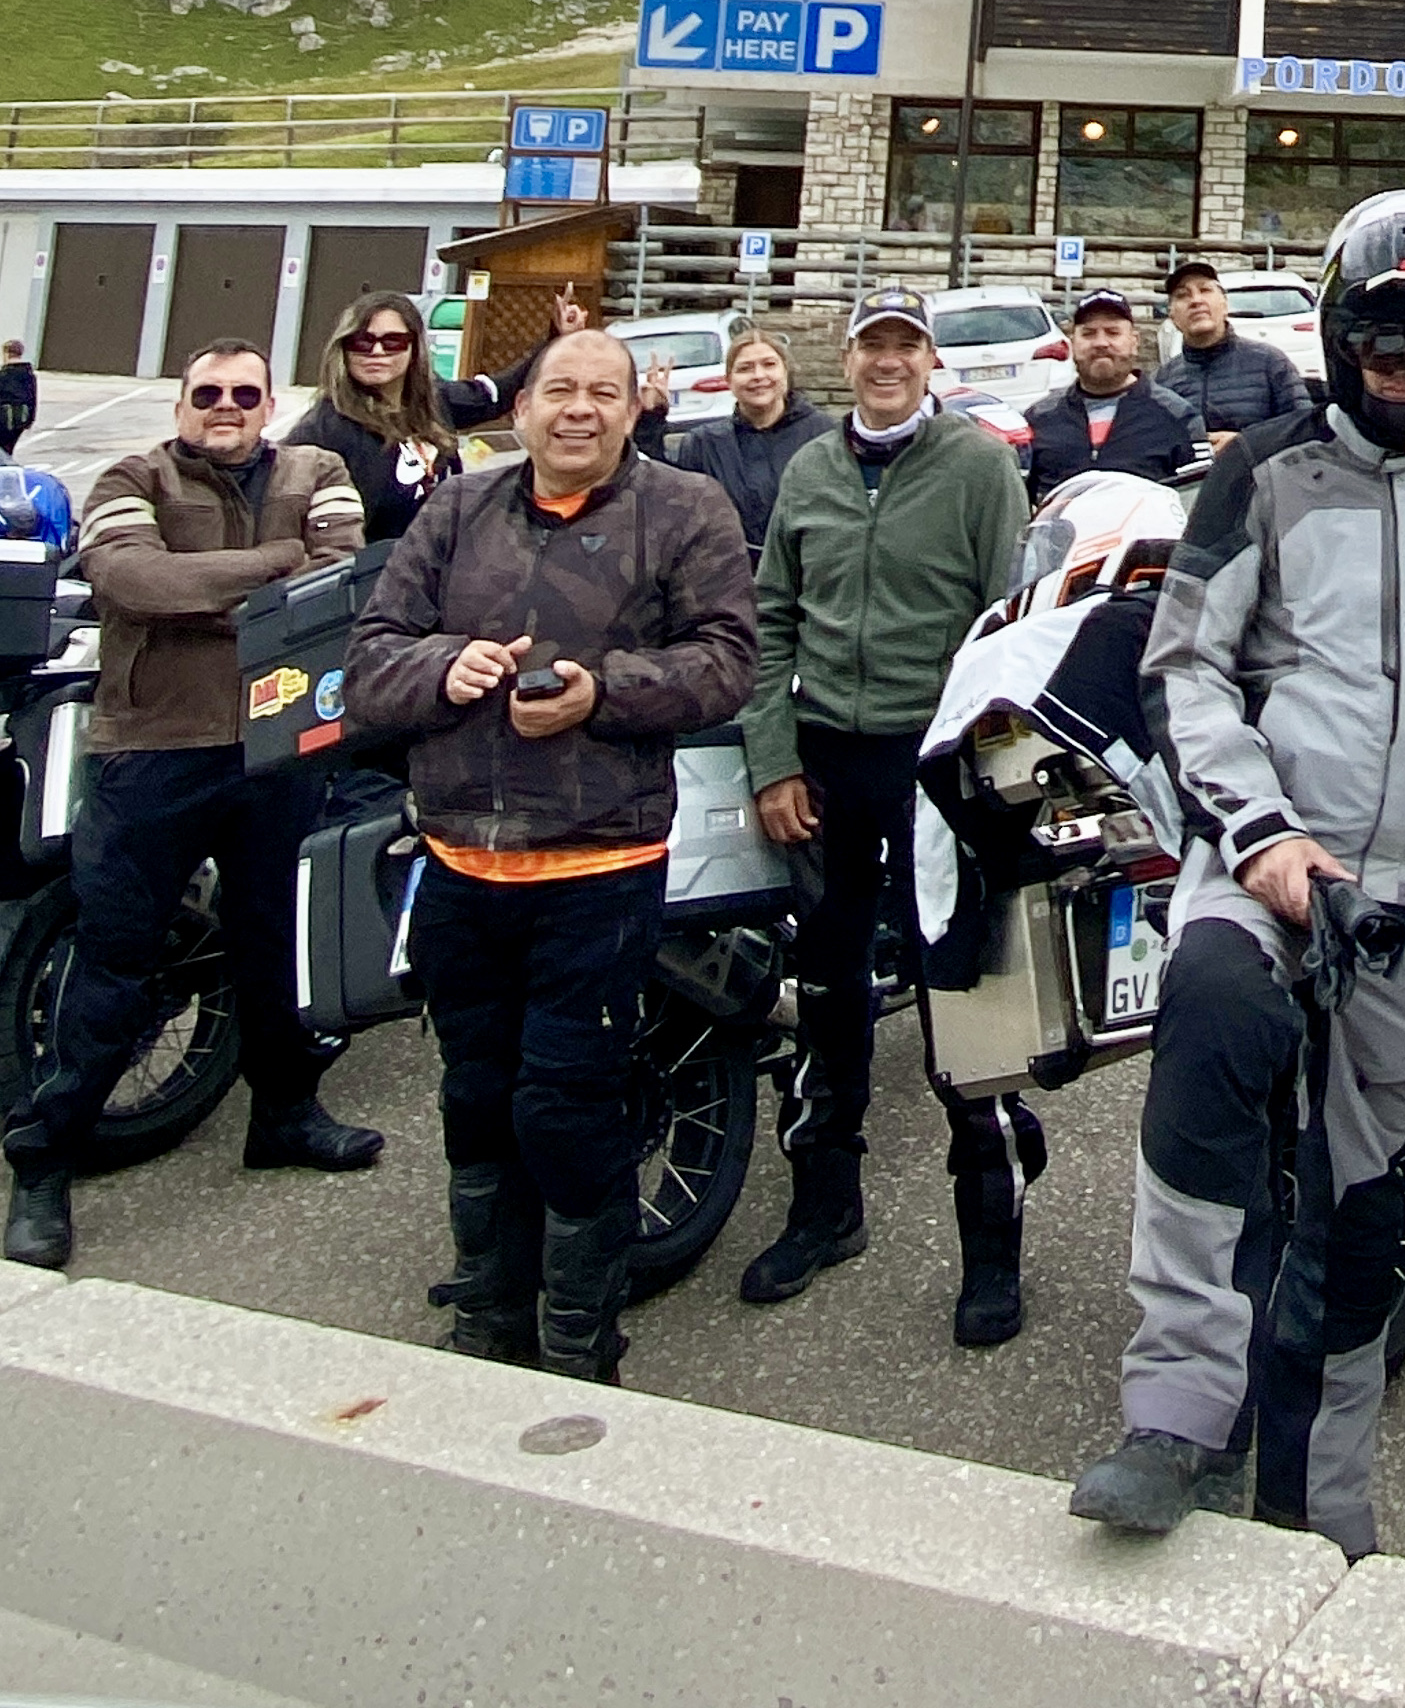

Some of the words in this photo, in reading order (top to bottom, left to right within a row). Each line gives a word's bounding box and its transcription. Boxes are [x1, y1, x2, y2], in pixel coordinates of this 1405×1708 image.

[736, 10, 790, 34] PAY
[724, 38, 796, 62] HERE
[814, 7, 869, 69] P
[567, 117, 589, 142] P
[749, 237, 764, 255] P
[1063, 242, 1077, 259] P
[1112, 972, 1149, 1014] GV
